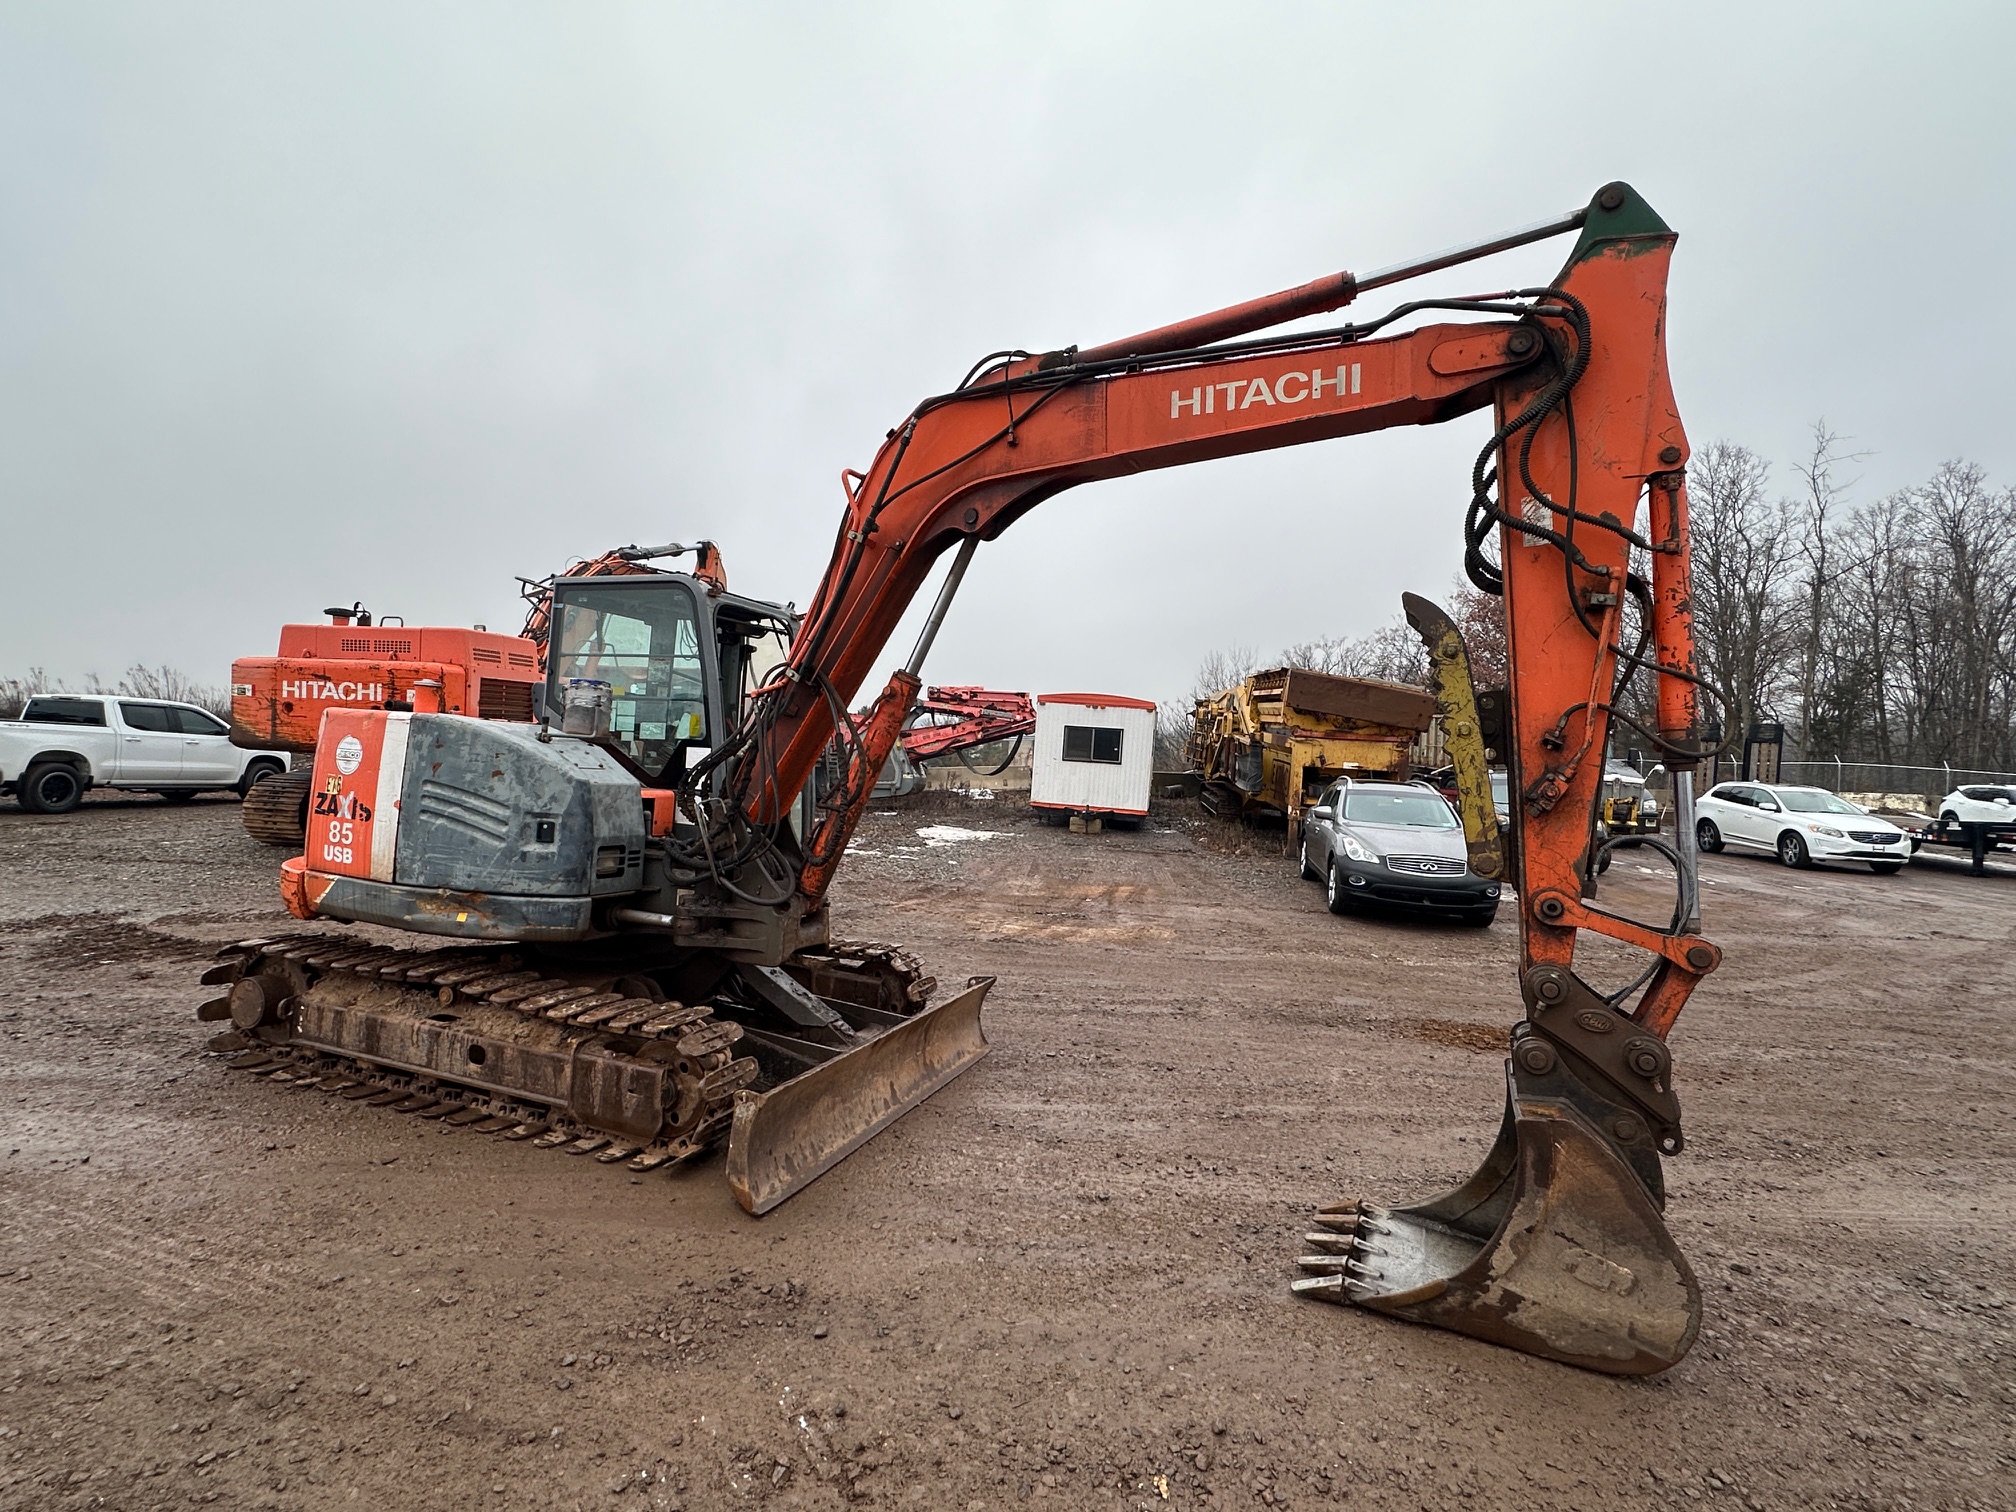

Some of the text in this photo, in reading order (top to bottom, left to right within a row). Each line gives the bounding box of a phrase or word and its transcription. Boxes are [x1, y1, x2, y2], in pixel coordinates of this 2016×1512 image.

[1171, 363, 1362, 419] HITACHI
[282, 680, 383, 701] HITACHI
[329, 820, 353, 845] 85
[324, 844, 353, 864] USB
